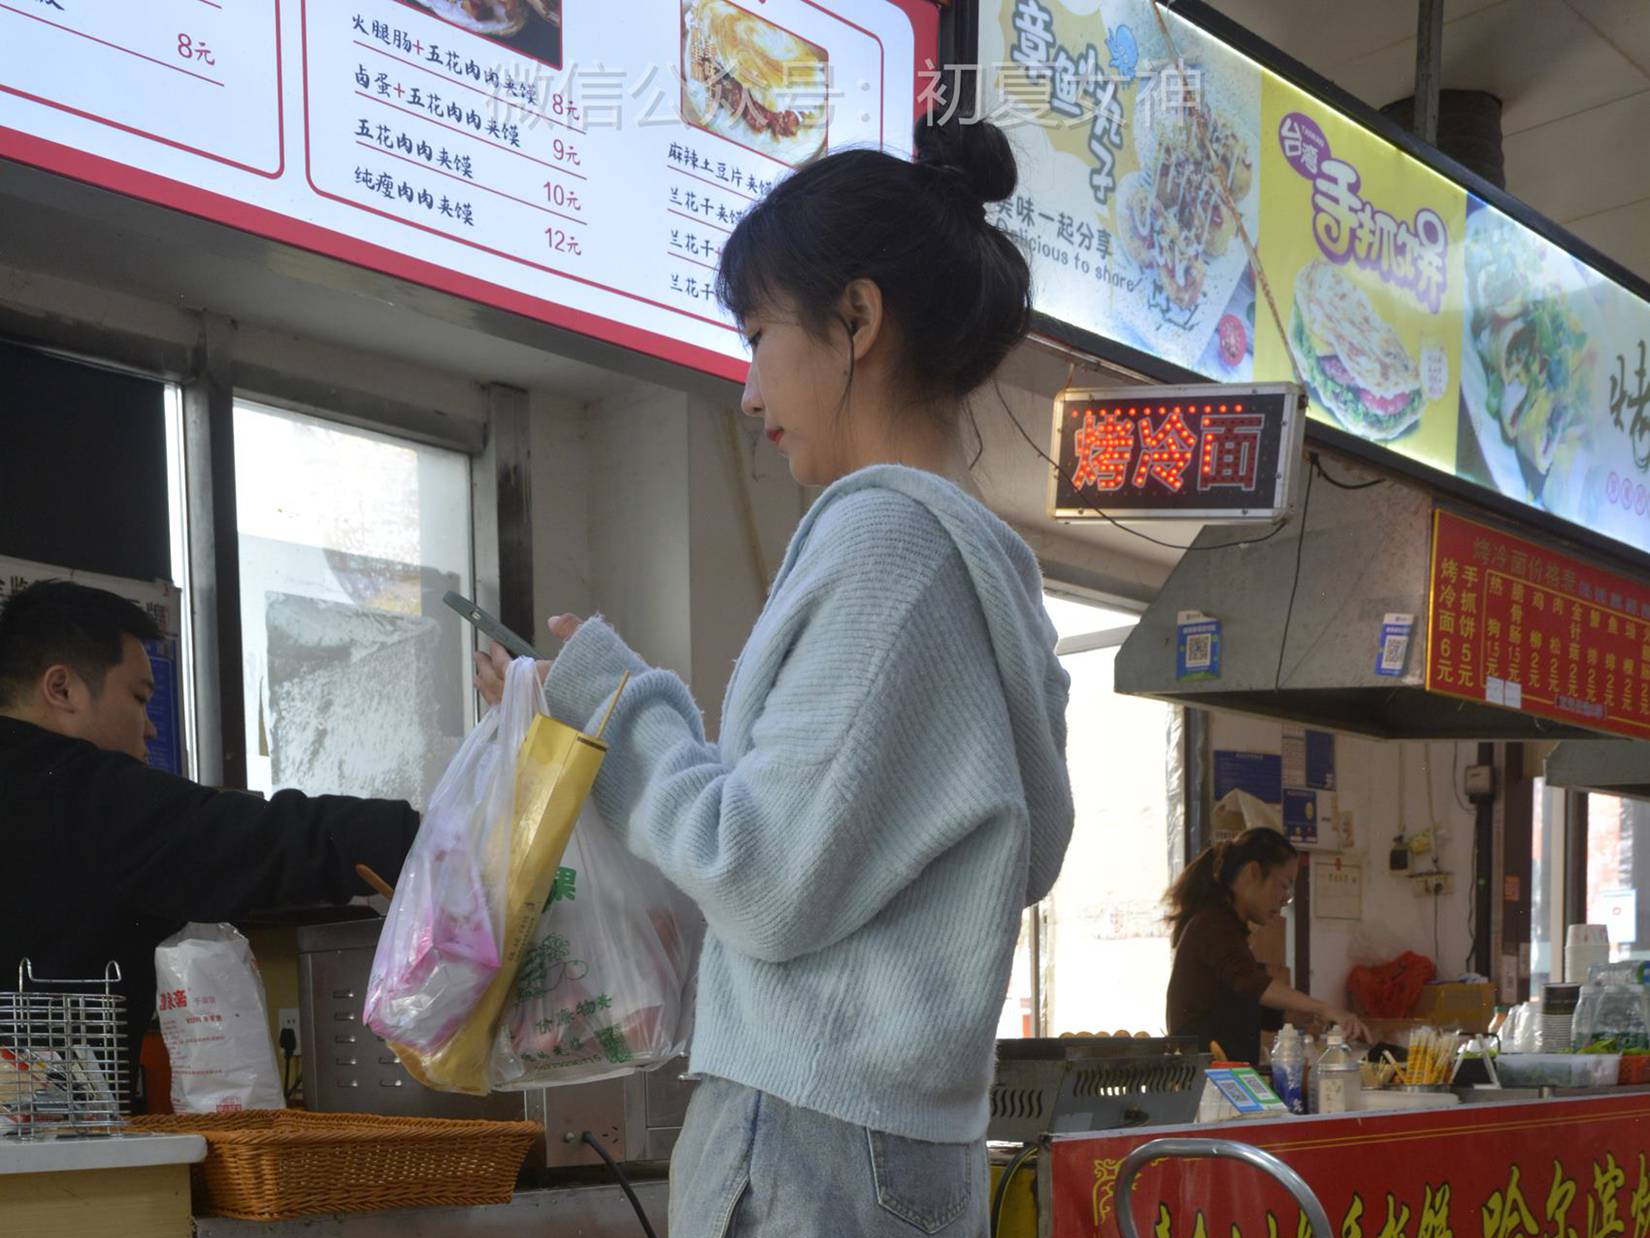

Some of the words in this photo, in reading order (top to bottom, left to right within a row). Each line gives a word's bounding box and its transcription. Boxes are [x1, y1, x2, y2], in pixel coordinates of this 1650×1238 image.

[177, 33, 216, 66] 8元
[552, 93, 581, 121] 8元
[355, 118, 474, 180] 五花肉肉夹馍
[543, 181, 582, 211] 10元
[553, 138, 581, 166] 9元
[1281, 117, 1318, 175] 台湾
[354, 166, 475, 227] 纯瘦肉肉夹馍
[544, 227, 582, 256] 12元
[1314, 159, 1446, 310] 手抓饼
[1074, 254, 1090, 274] to
[1072, 413, 1265, 491] 烤冷面
[1457, 565, 1478, 688] 手抓饼5元
